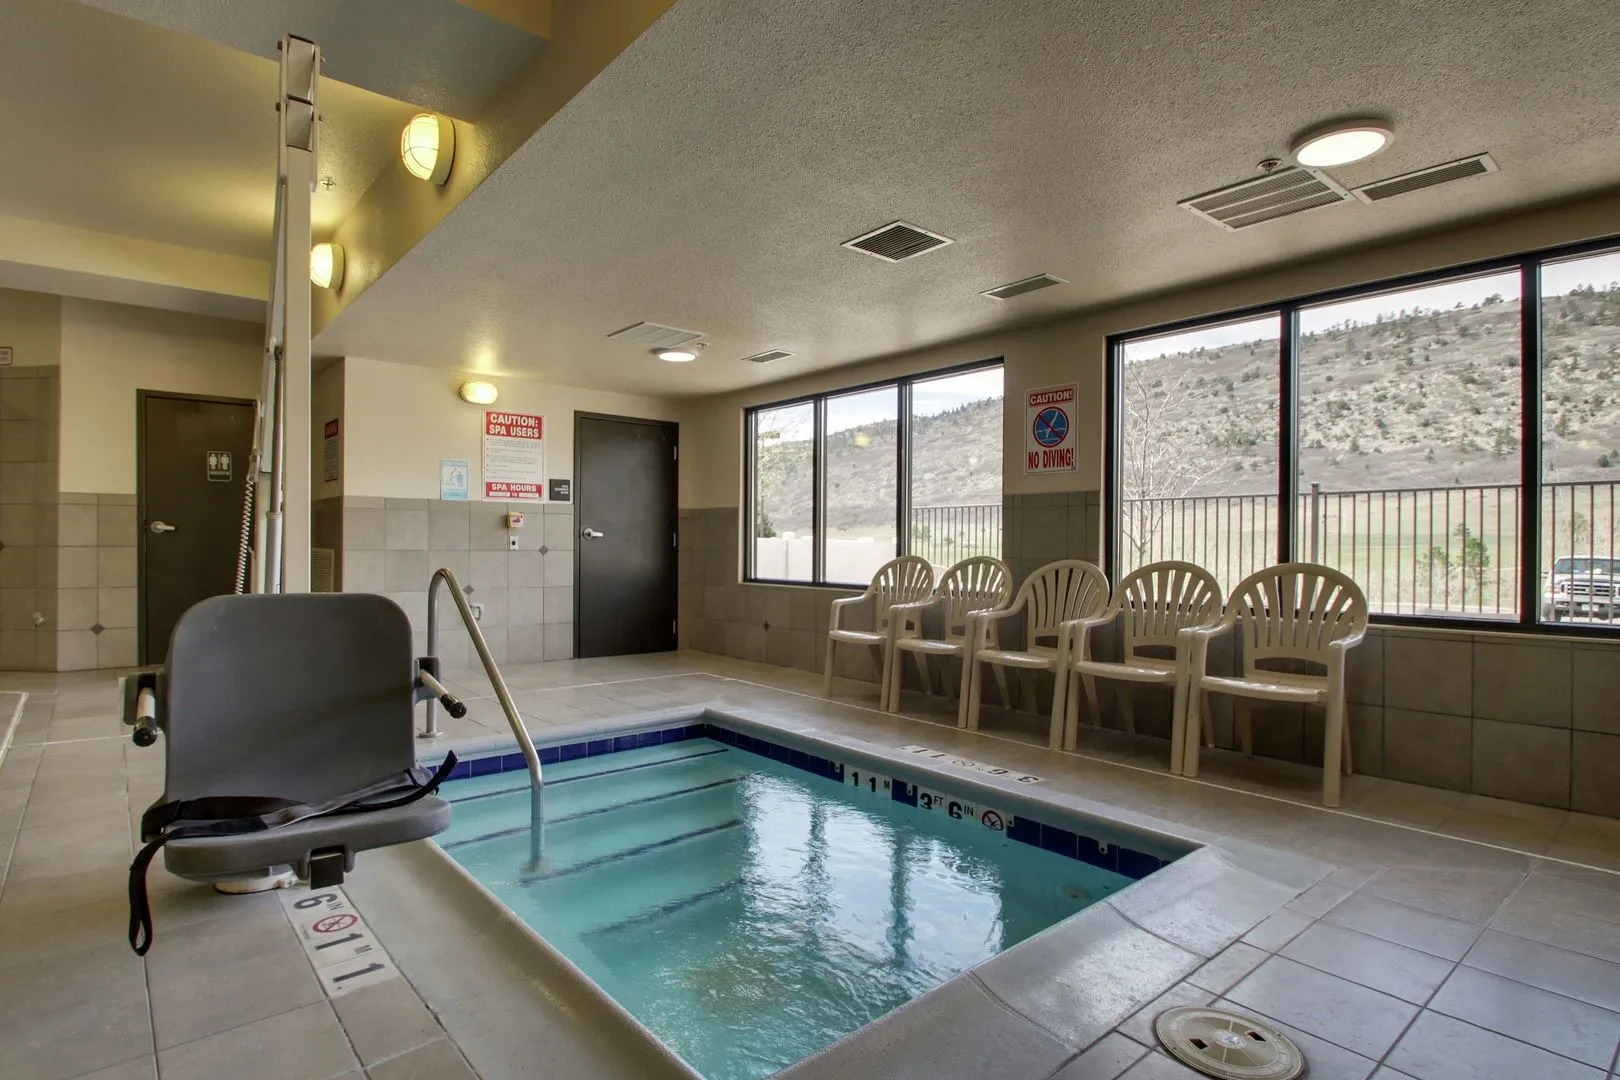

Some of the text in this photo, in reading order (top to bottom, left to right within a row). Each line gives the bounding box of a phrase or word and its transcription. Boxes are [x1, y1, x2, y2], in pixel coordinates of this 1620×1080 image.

[1030, 390, 1073, 405] CAUTION!
[490, 413, 538, 427] CAUTION:
[489, 424, 539, 438] SPA USERS
[1028, 447, 1074, 470] NO DIVING!
[491, 483, 537, 492] SPA HOURS
